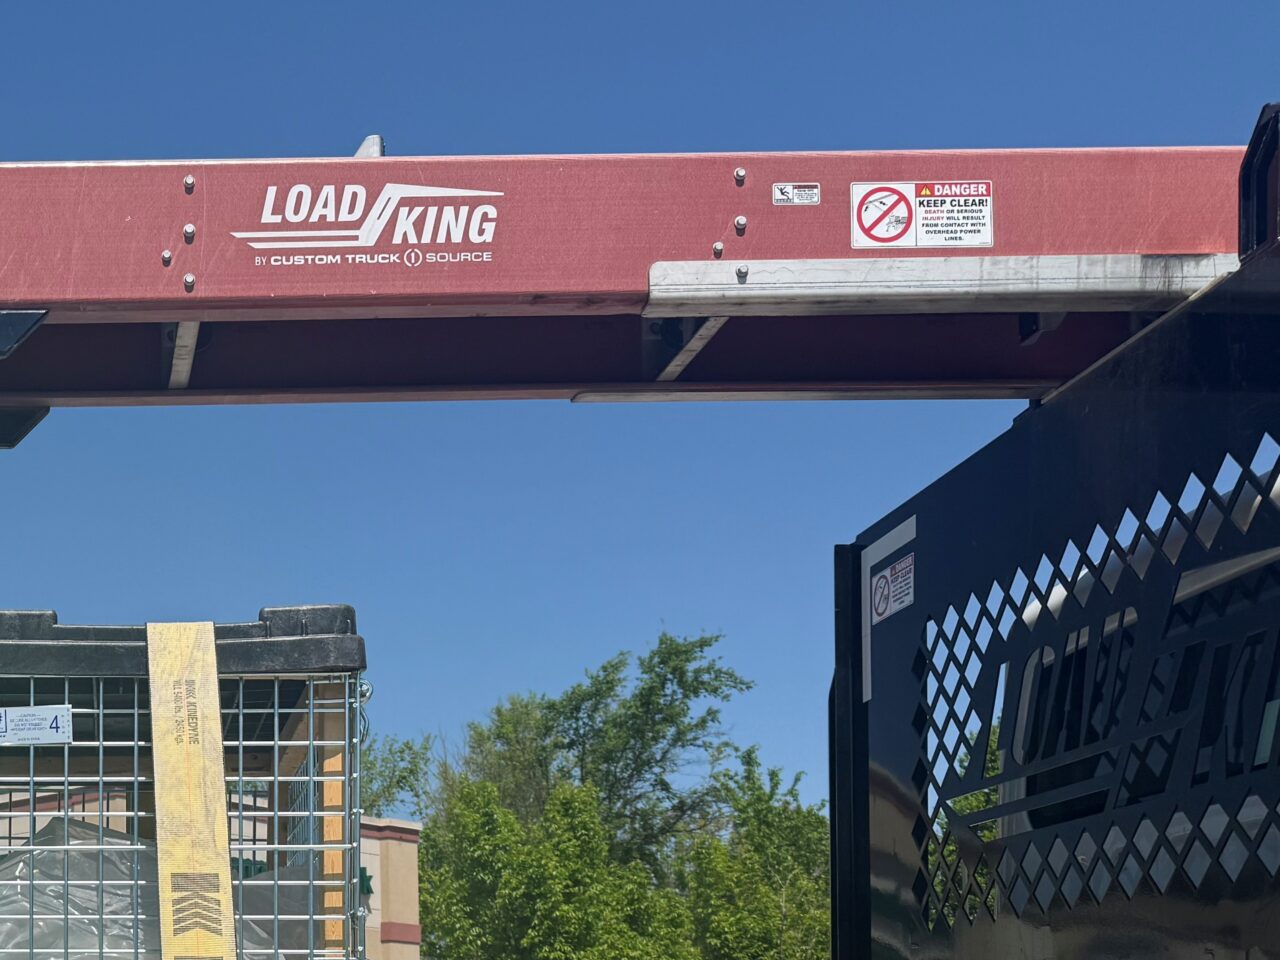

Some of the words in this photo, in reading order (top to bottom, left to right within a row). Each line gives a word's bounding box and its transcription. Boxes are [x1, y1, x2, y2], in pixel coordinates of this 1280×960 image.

[934, 184, 987, 195] DANGER
[261, 184, 366, 223] LOAD
[918, 199, 946, 208] KEEP
[949, 198, 988, 207] CLEAR!
[392, 205, 497, 244] KING
[255, 256, 267, 265] BY
[270, 255, 341, 265] CUSTOM
[345, 253, 401, 264] TRUCK
[425, 252, 493, 262] SOURCE
[49, 715, 60, 733] 4
